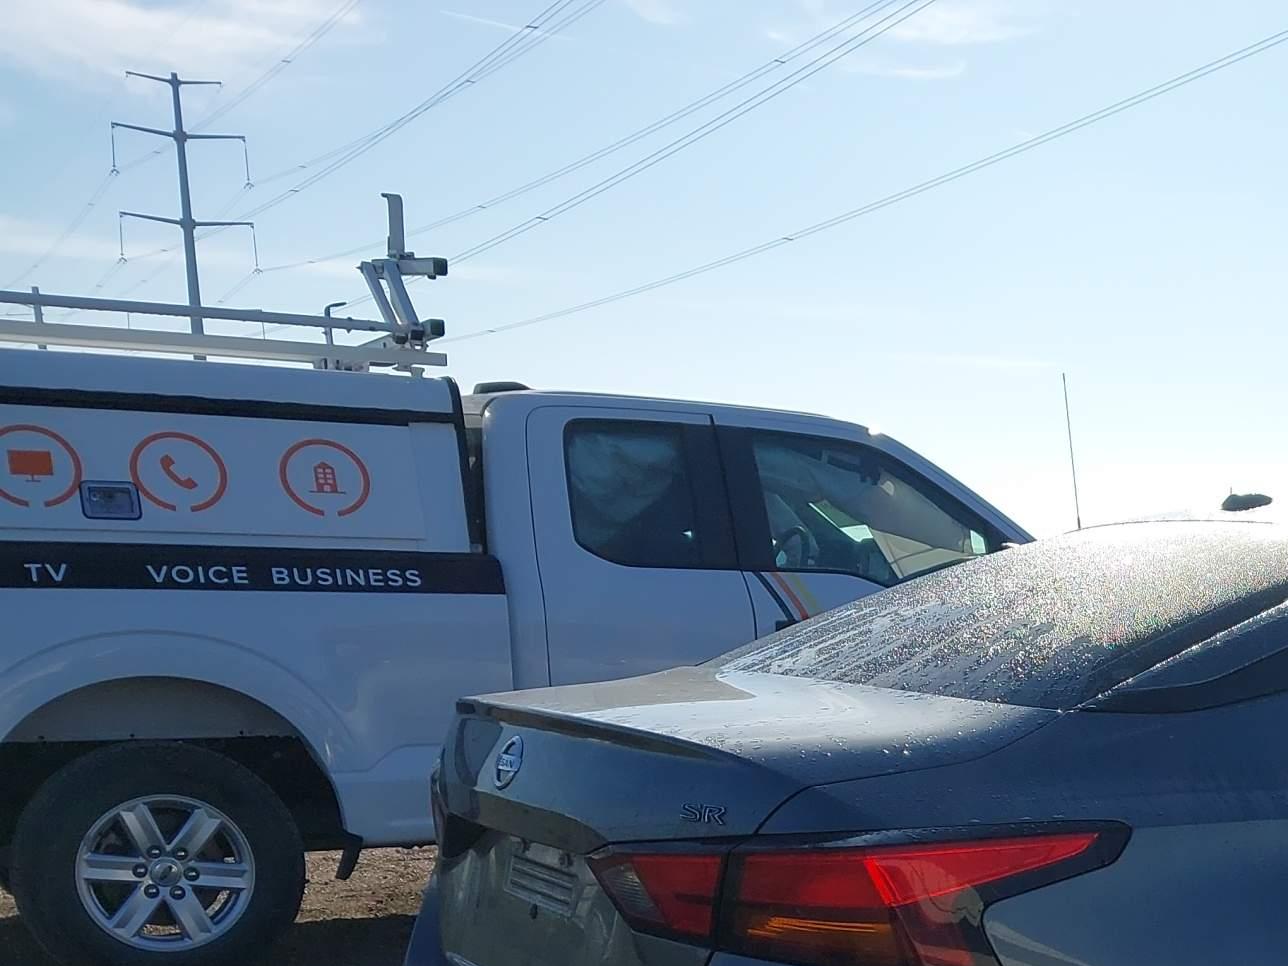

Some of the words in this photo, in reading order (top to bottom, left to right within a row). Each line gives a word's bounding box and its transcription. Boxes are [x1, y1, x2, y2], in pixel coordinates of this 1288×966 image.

[24, 563, 67, 583] TV
[146, 565, 249, 585] VOICE
[271, 567, 422, 587] BUSINESS
[680, 803, 726, 825] SR
